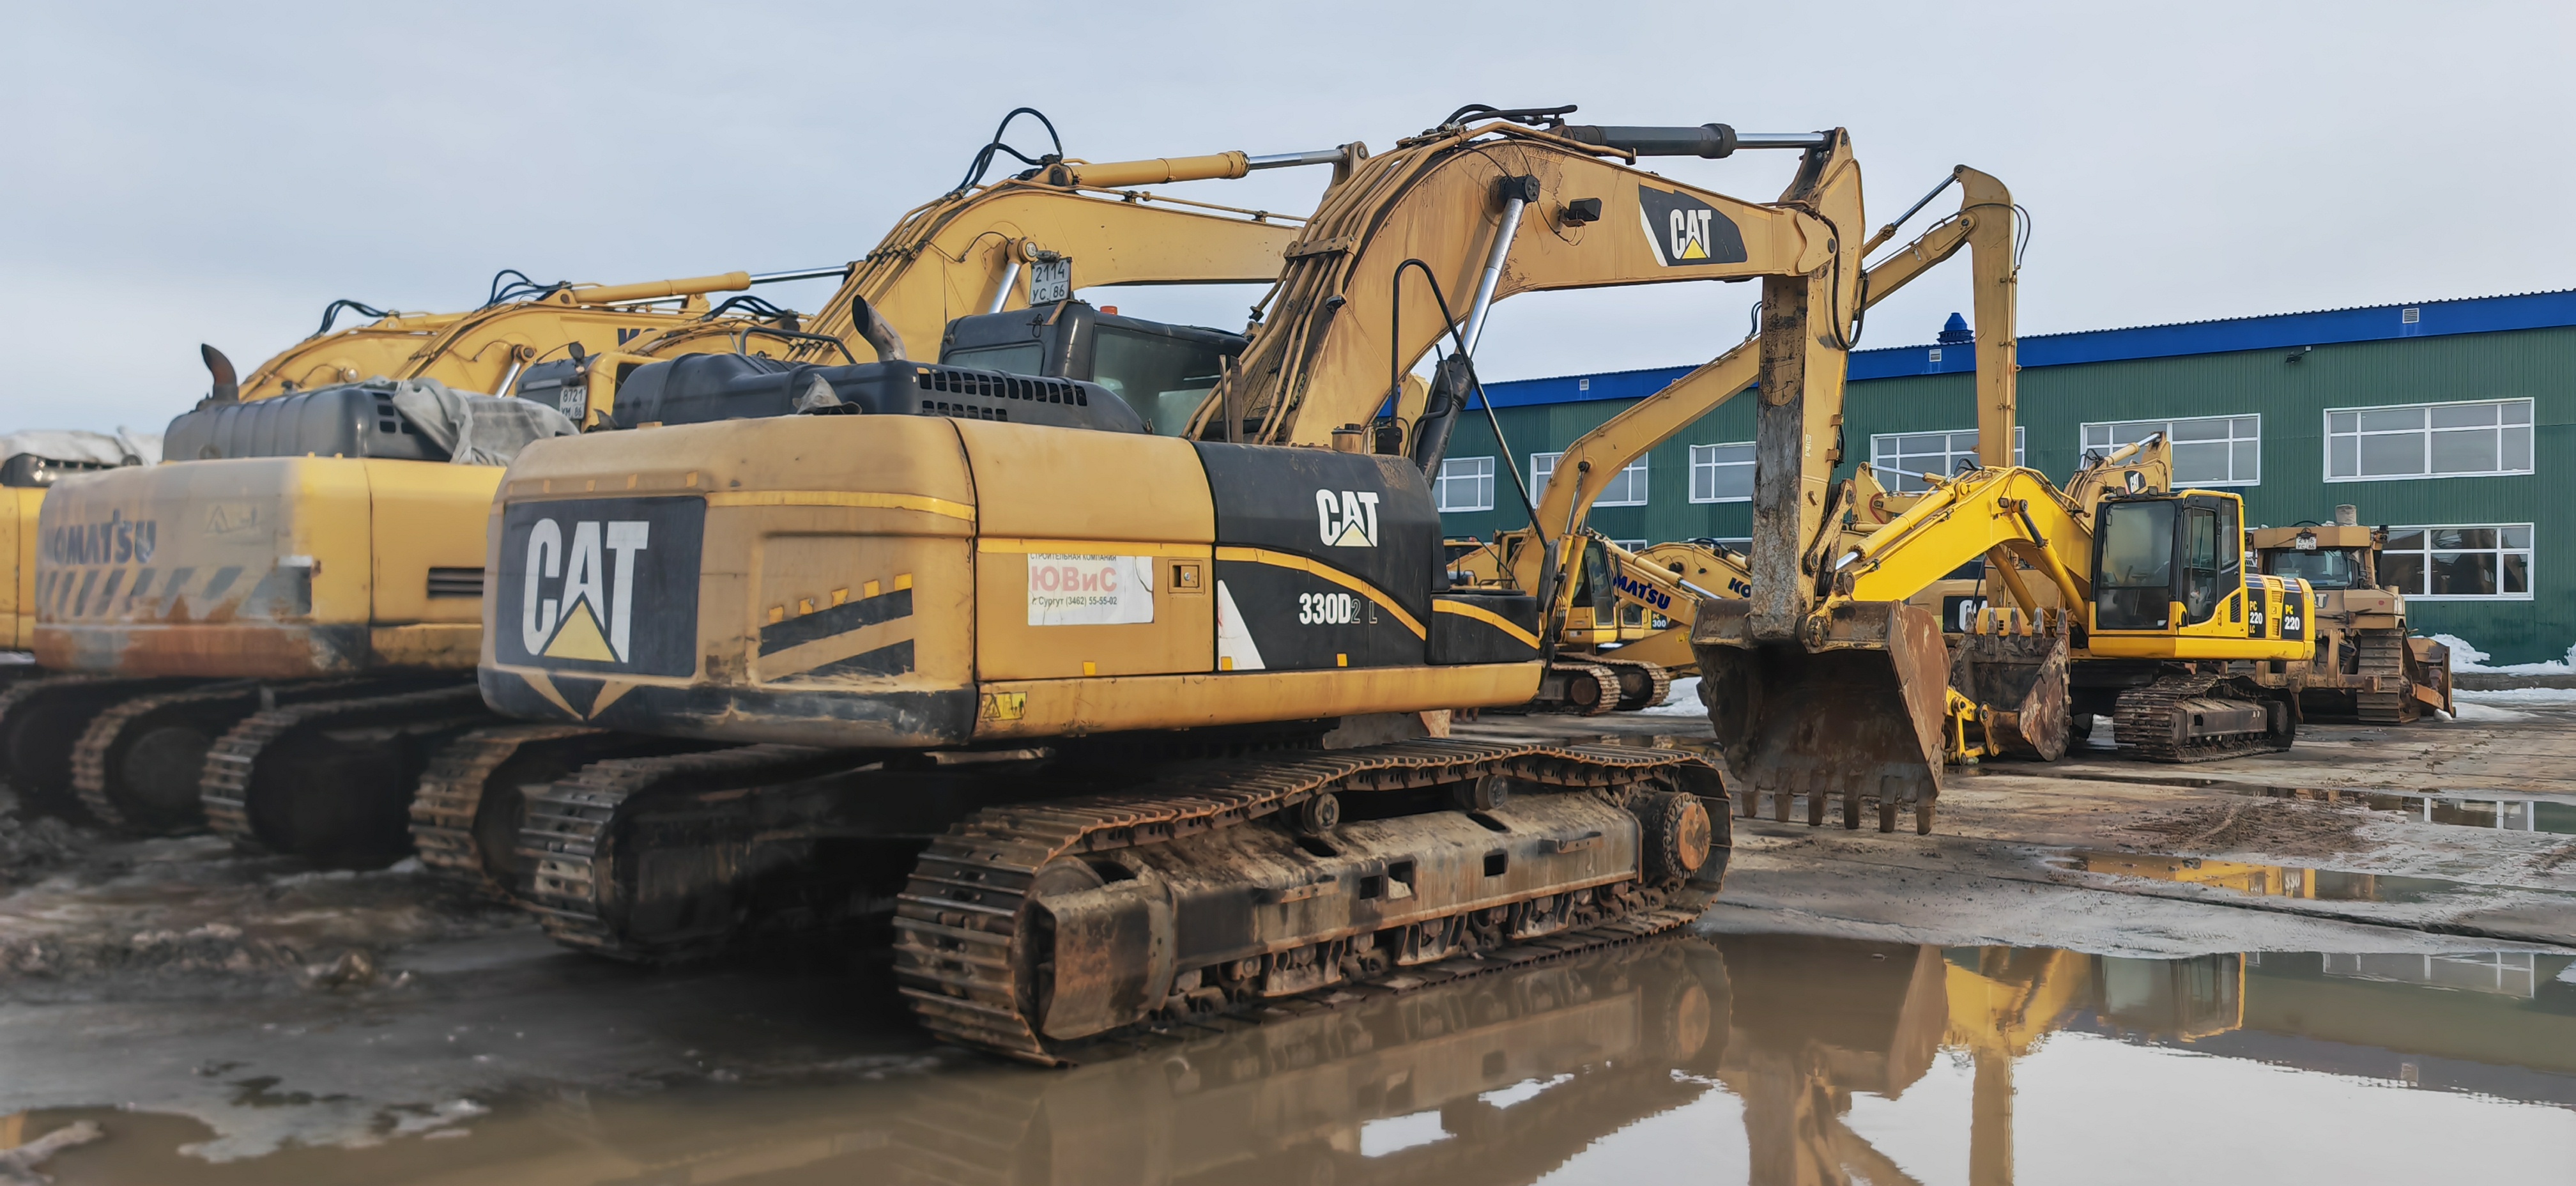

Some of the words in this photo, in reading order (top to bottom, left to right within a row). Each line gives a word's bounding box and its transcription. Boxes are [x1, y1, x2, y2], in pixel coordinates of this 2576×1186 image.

[1669, 208, 1712, 259] CAT
[1035, 261, 1066, 283] 2114
[1053, 284, 1065, 298] 86
[562, 389, 583, 403] 8721
[1315, 489, 1380, 548] CAT
[1031, 566, 1118, 592] ЮВиС
[522, 518, 650, 663] CAT
[1038, 596, 1064, 608] Сургут
[1065, 596, 1087, 607] (3462)
[1089, 596, 1118, 606] 55-55-02
[2249, 600, 2258, 612] PC
[1368, 600, 1378, 624] L
[2285, 604, 2294, 615] PC
[1652, 619, 1667, 628] 300
[2249, 612, 2264, 625] 220
[2284, 616, 2301, 631] 220
[2249, 624, 2256, 634] LC
